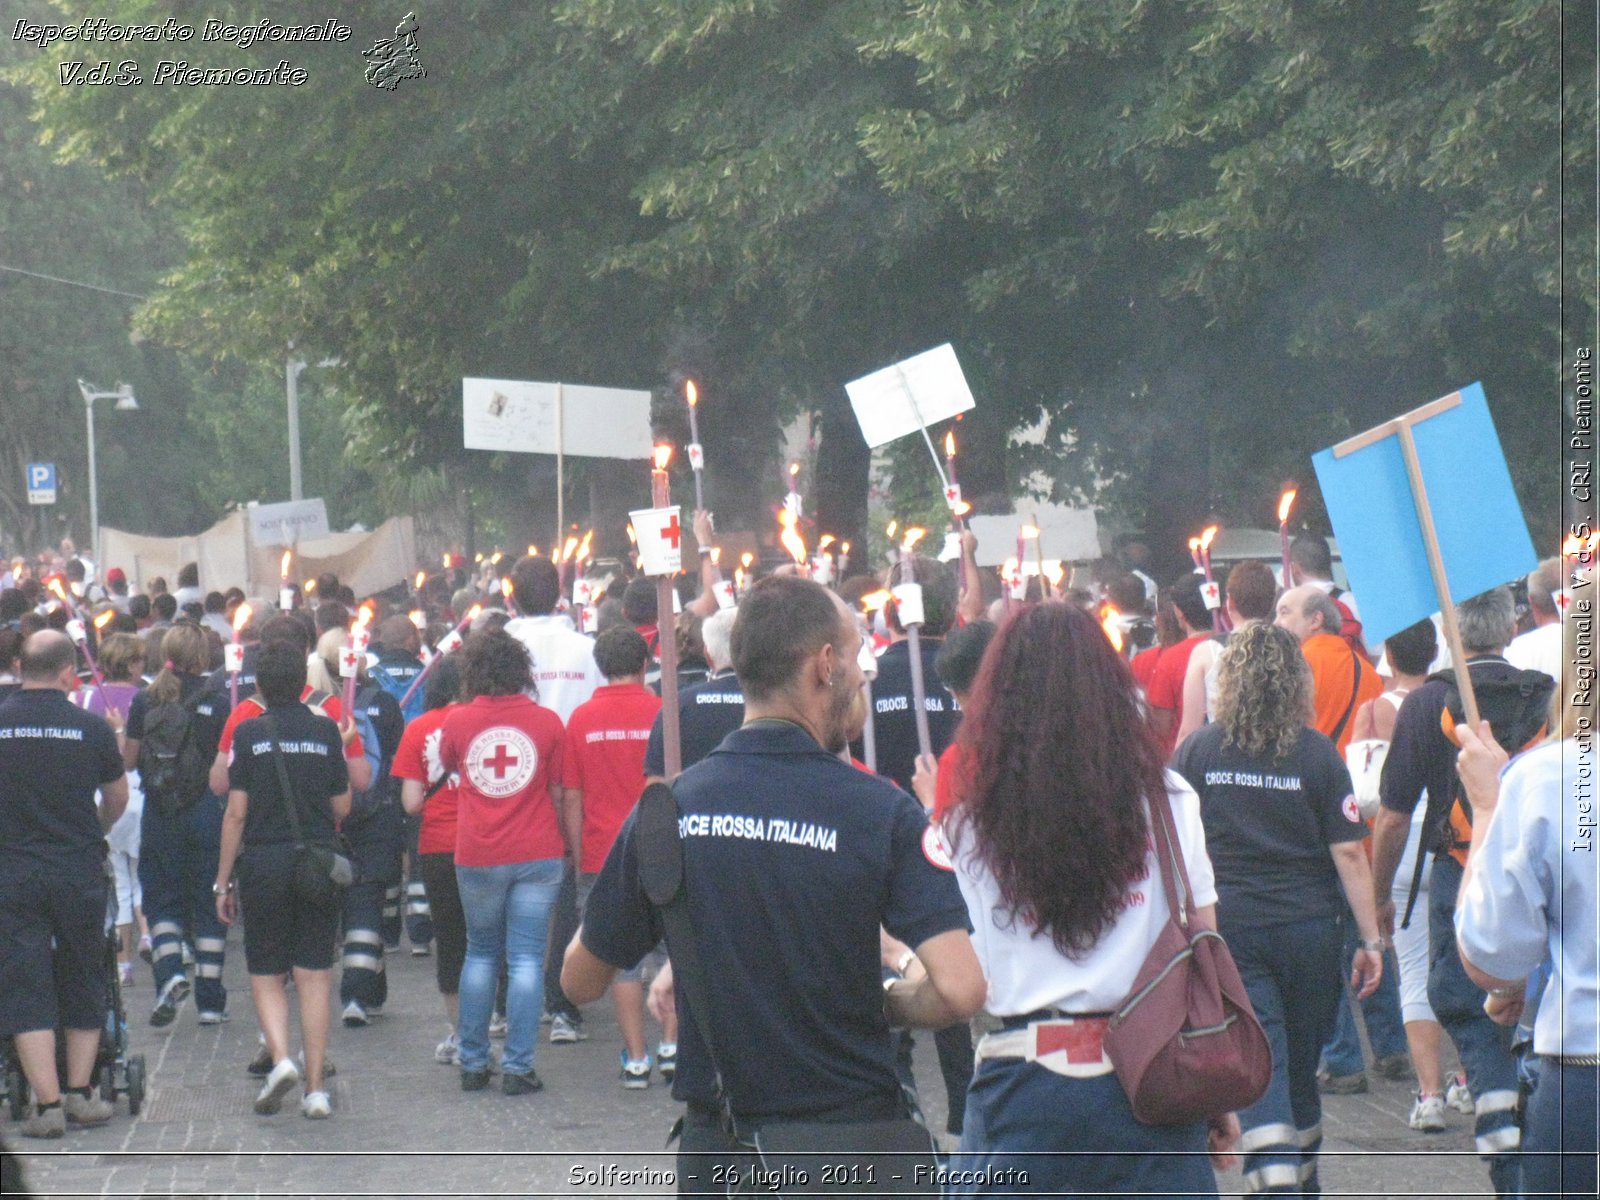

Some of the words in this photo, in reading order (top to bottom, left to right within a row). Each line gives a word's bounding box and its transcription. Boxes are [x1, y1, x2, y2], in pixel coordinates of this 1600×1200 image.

[32, 466, 49, 488] P
[696, 694, 721, 704] CROCE
[722, 694, 744, 704] ROSS
[876, 696, 908, 713] CROCE
[14, 728, 42, 738] ROSSA
[44, 728, 83, 741] ITALIANA
[252, 741, 273, 756] CROC
[1205, 771, 1233, 785] CROCE
[1235, 773, 1263, 787] ROSSA
[1265, 776, 1302, 790] ITALIANA
[711, 815, 765, 841] ROSSA
[766, 819, 838, 852] ITALIANA
